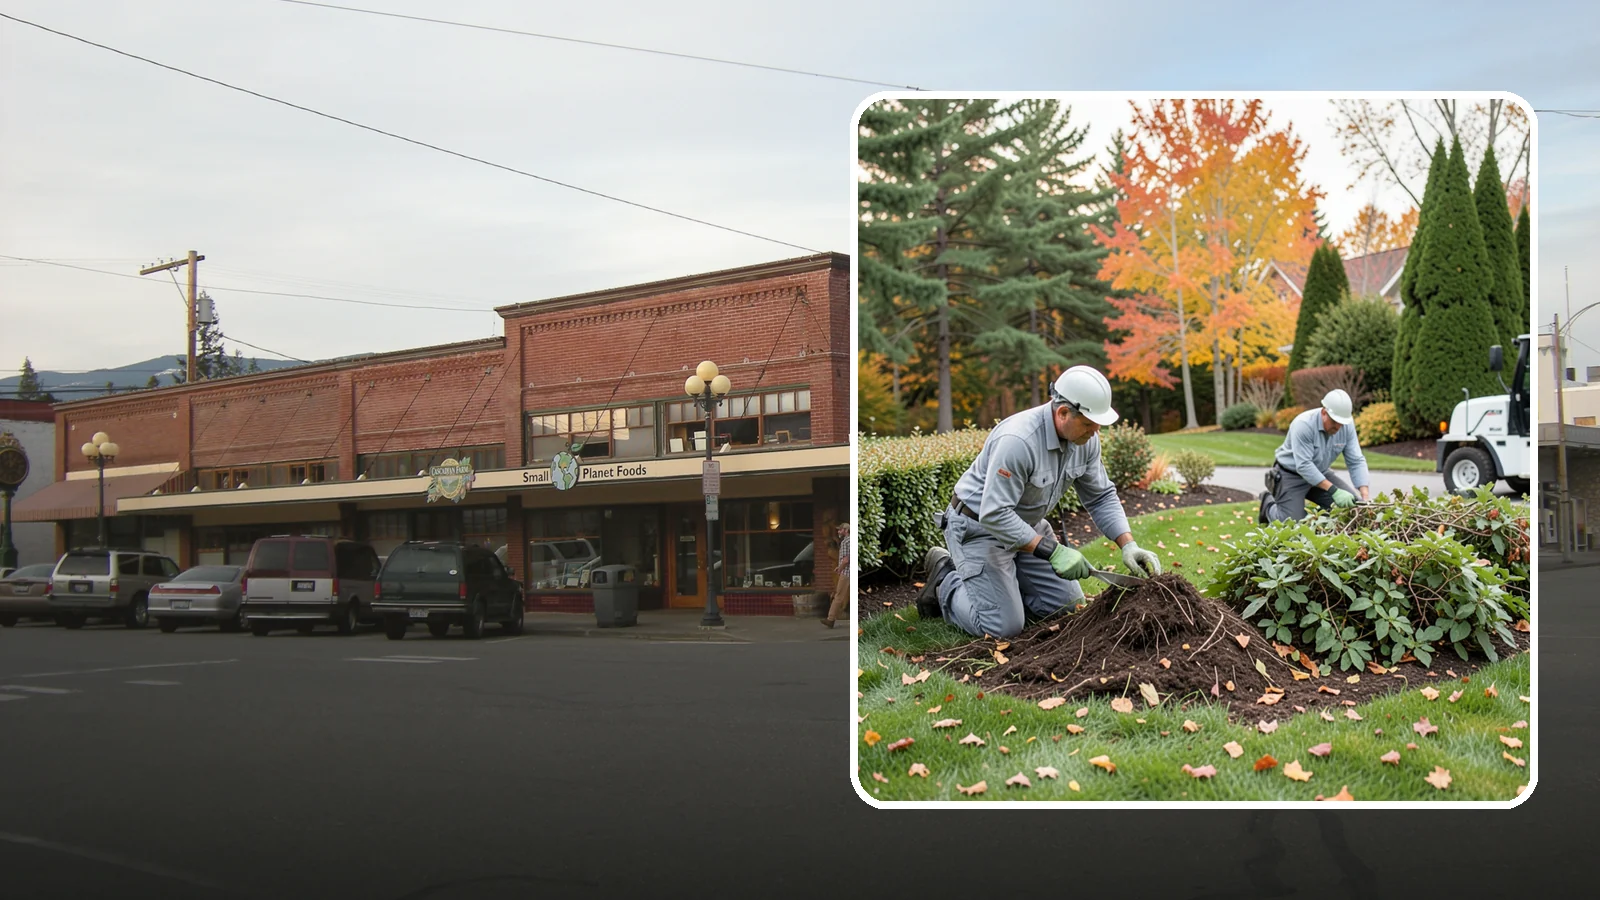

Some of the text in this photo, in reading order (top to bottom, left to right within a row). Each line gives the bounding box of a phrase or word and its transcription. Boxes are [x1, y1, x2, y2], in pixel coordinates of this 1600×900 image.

[456, 465, 469, 474] FARM
[523, 464, 647, 483] Small Planet Foods
